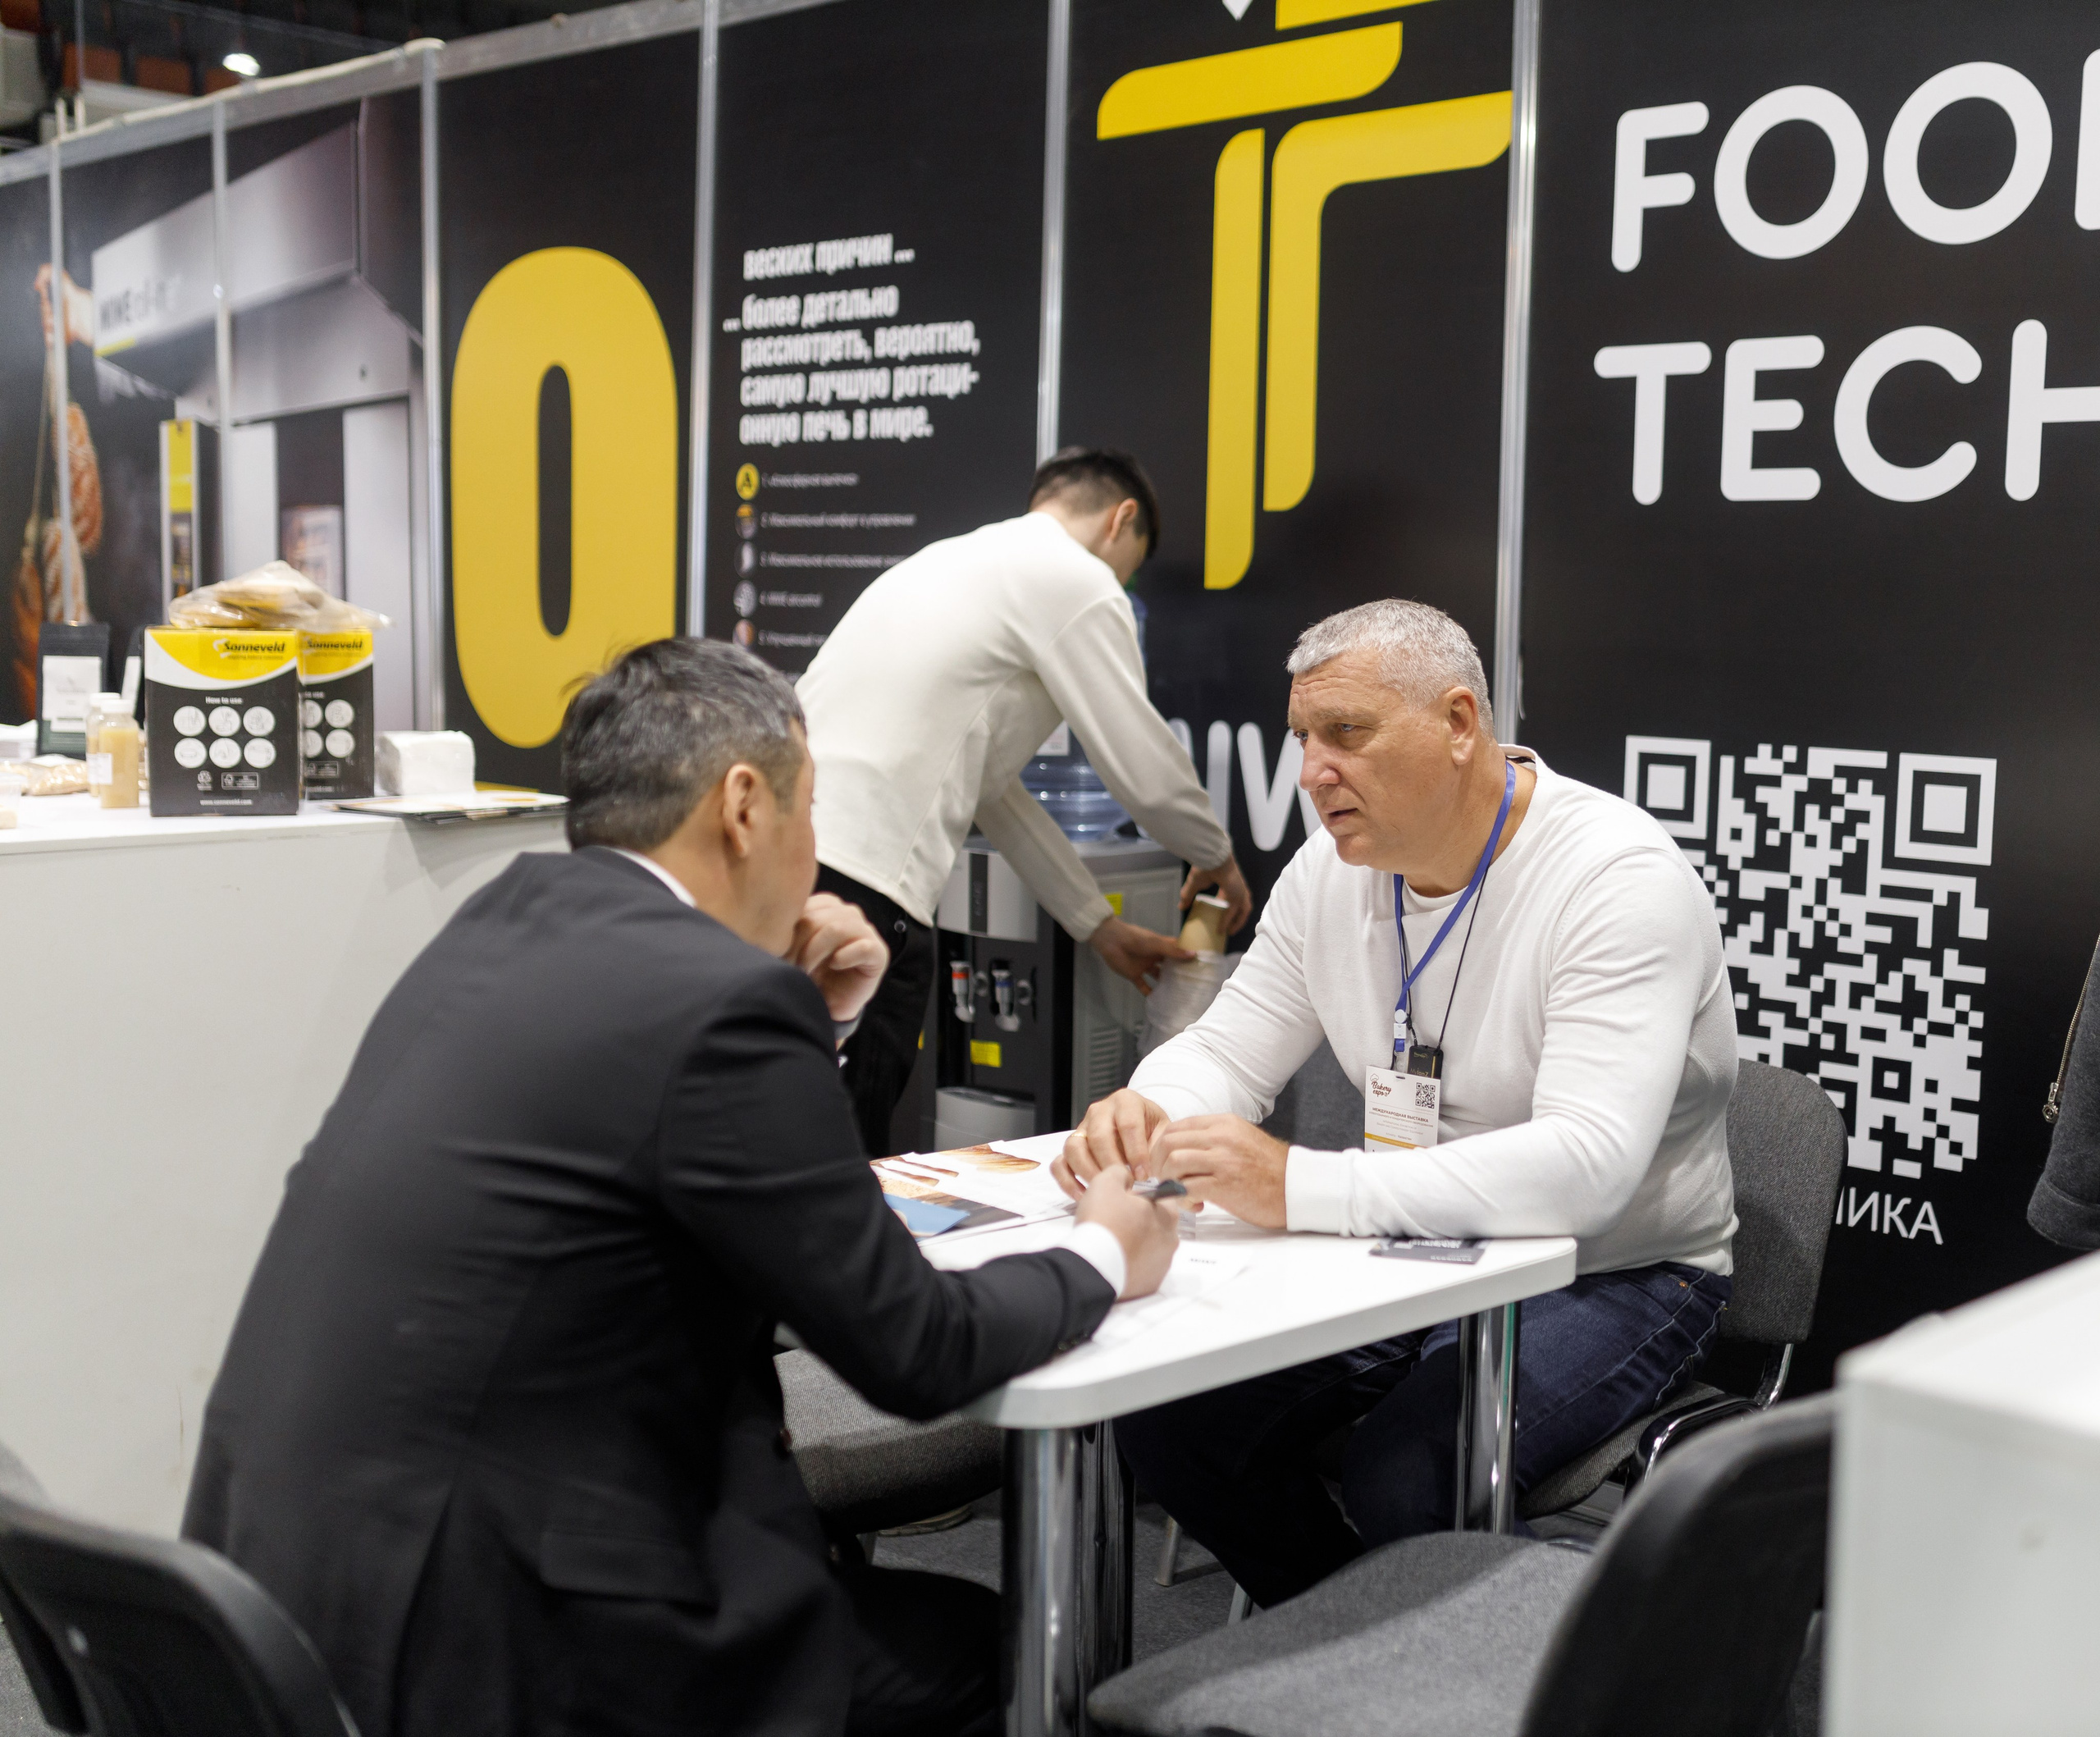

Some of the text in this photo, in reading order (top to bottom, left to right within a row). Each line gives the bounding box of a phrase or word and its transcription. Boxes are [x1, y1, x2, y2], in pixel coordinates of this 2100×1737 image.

[1611, 48, 2100, 272] FOO
[743, 243, 815, 281] веских
[815, 233, 893, 276] причин
[742, 294, 801, 330] более
[801, 286, 899, 329] детально
[741, 321, 980, 373] рассмотреть, вероятно,
[741, 363, 979, 409] самую лучшую ротаци-
[739, 406, 934, 447] онную печь в мире.
[223, 641, 285, 653] Sonneveld
[307, 638, 363, 651] Sonneveld
[205, 697, 221, 705] How
[229, 697, 243, 705] use
[1372, 1081, 1392, 1095] Bakery
[1372, 1107, 1406, 1118] МЕЖДУНАРОДНАЯ
[1407, 1114, 1429, 1123] ВЫСТАВКА
[1836, 1186, 1944, 1246] ИКА
